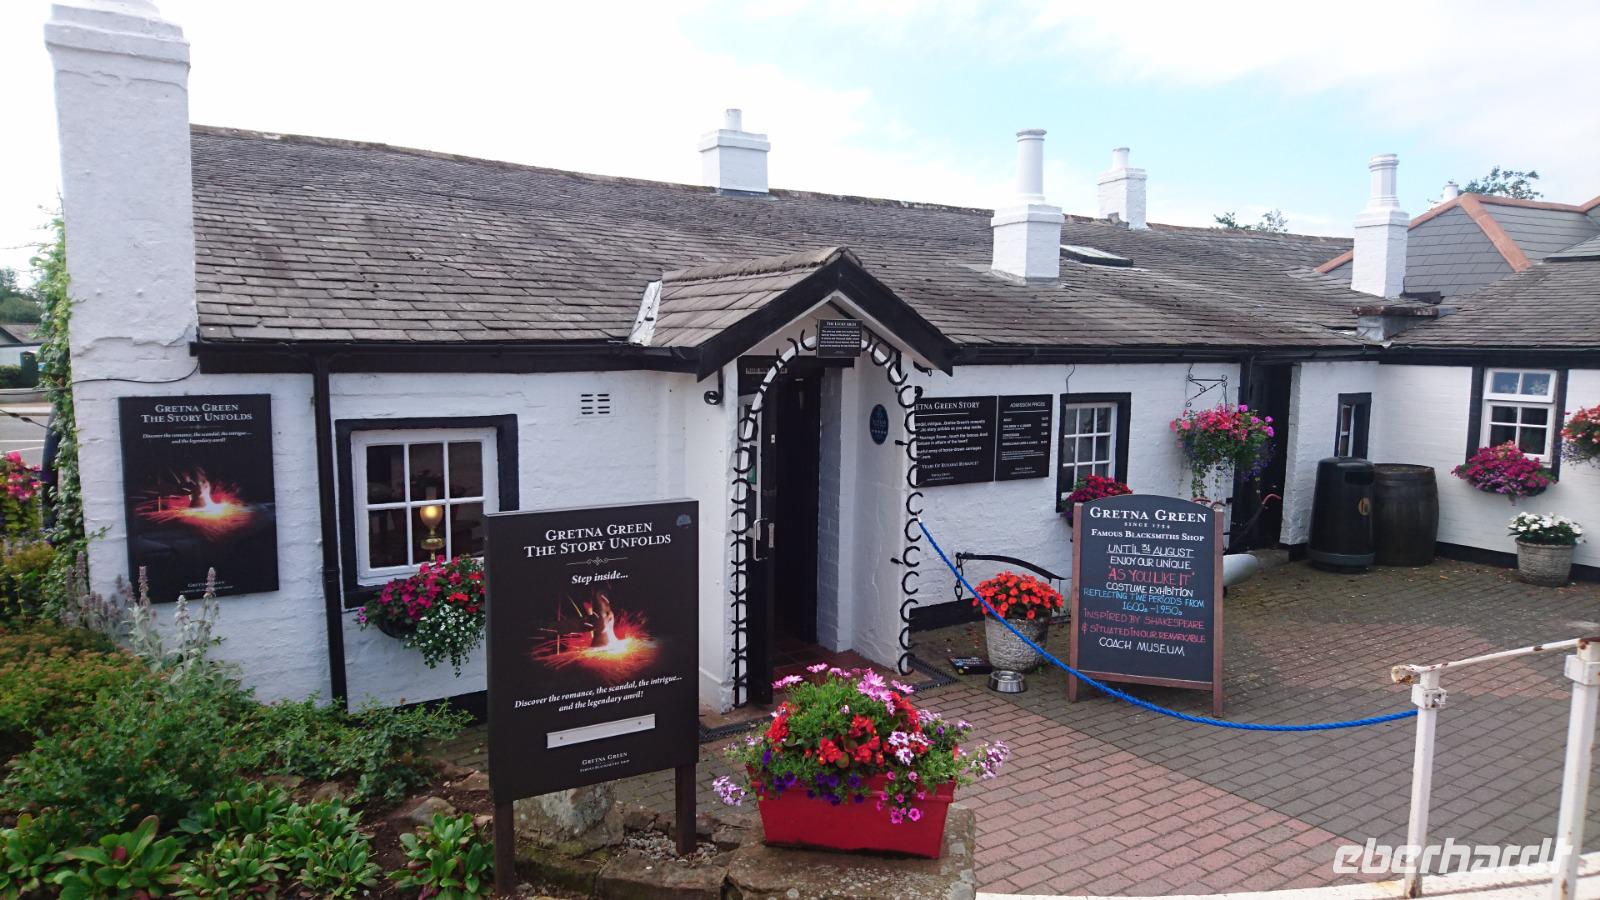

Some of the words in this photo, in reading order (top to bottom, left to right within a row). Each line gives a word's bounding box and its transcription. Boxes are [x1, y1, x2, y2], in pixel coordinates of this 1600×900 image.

[154, 404, 200, 413] GRETNA
[201, 403, 239, 412] GREEN
[915, 403, 933, 411] ETNA
[934, 401, 958, 410] GREEN
[959, 401, 980, 409] STORY
[141, 414, 165, 423] THE
[167, 413, 202, 423] STORY
[204, 413, 253, 422] UNFOLDS
[1089, 506, 1149, 520] GRETNA
[1154, 509, 1207, 523] GREEN
[545, 527, 603, 541] GRETNA
[606, 522, 653, 536] GREEN
[1091, 528, 1123, 538] FAMOUS
[1125, 530, 1180, 540] BLACKSMITHS
[1181, 533, 1205, 542] SHOP
[524, 545, 557, 558] THE
[560, 540, 606, 555] STORY
[609, 534, 671, 549] UNFOLDS
[1107, 543, 1141, 555] UNTIL
[1152, 548, 1194, 558] AUGUST
[1110, 556, 1137, 565] ENJOY
[1137, 559, 1154, 567] OUR
[1155, 560, 1192, 570] UNIQUE
[571, 574, 592, 586] Step
[594, 570, 629, 582] inside...
[1130, 570, 1152, 583] YOU
[1153, 571, 1177, 586] LIKE
[1105, 582, 1147, 594] COSTUME
[1149, 585, 1194, 598] EXHIBITION
[1083, 588, 1128, 600] REFLECTING
[1149, 595, 1183, 606] PERIODS
[1185, 600, 1205, 609] FROM
[1084, 608, 1128, 623] INSPIRED
[1144, 616, 1205, 630] SHAKESPEARE
[1090, 624, 1130, 638] SITUATED
[1158, 631, 1206, 644] REMARKABLE
[1099, 636, 1132, 650] COACH
[1136, 641, 1185, 657] MUSEUM
[514, 697, 548, 709] Discover
[548, 694, 561, 704] the
[561, 690, 595, 701] romance,
[596, 686, 608, 695] the
[608, 680, 638, 694] scandal,
[639, 679, 650, 687] the
[558, 703, 574, 712] and
[574, 701, 587, 709] the
[587, 694, 623, 709] legendary
[623, 691, 644, 701] anvil!
[582, 757, 606, 766] GRETNA
[607, 752, 628, 760] GREEN
